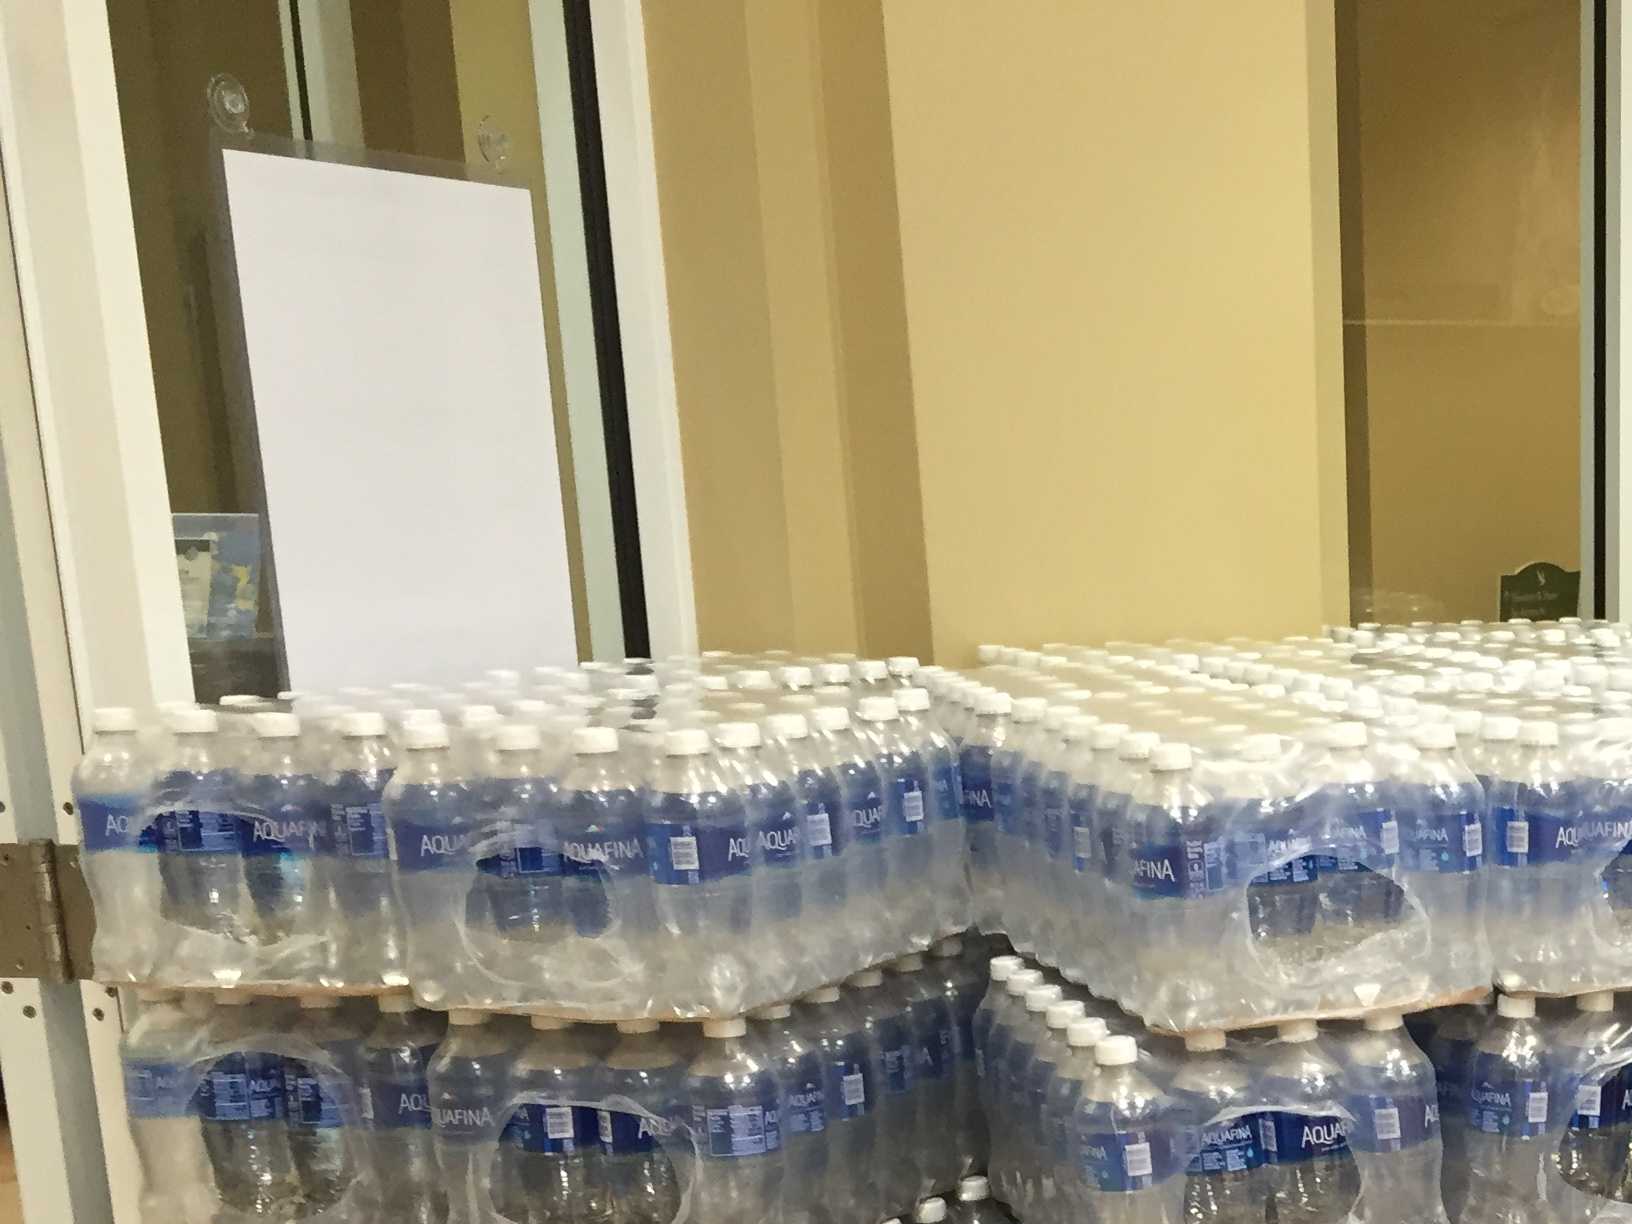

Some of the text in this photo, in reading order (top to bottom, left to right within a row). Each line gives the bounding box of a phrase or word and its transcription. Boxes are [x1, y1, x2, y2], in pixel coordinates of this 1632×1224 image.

[758, 825, 798, 849] AQUA
[563, 838, 644, 862] AQUAFINA
[1133, 857, 1175, 883] AFINA
[437, 1108, 494, 1128] UAFINA
